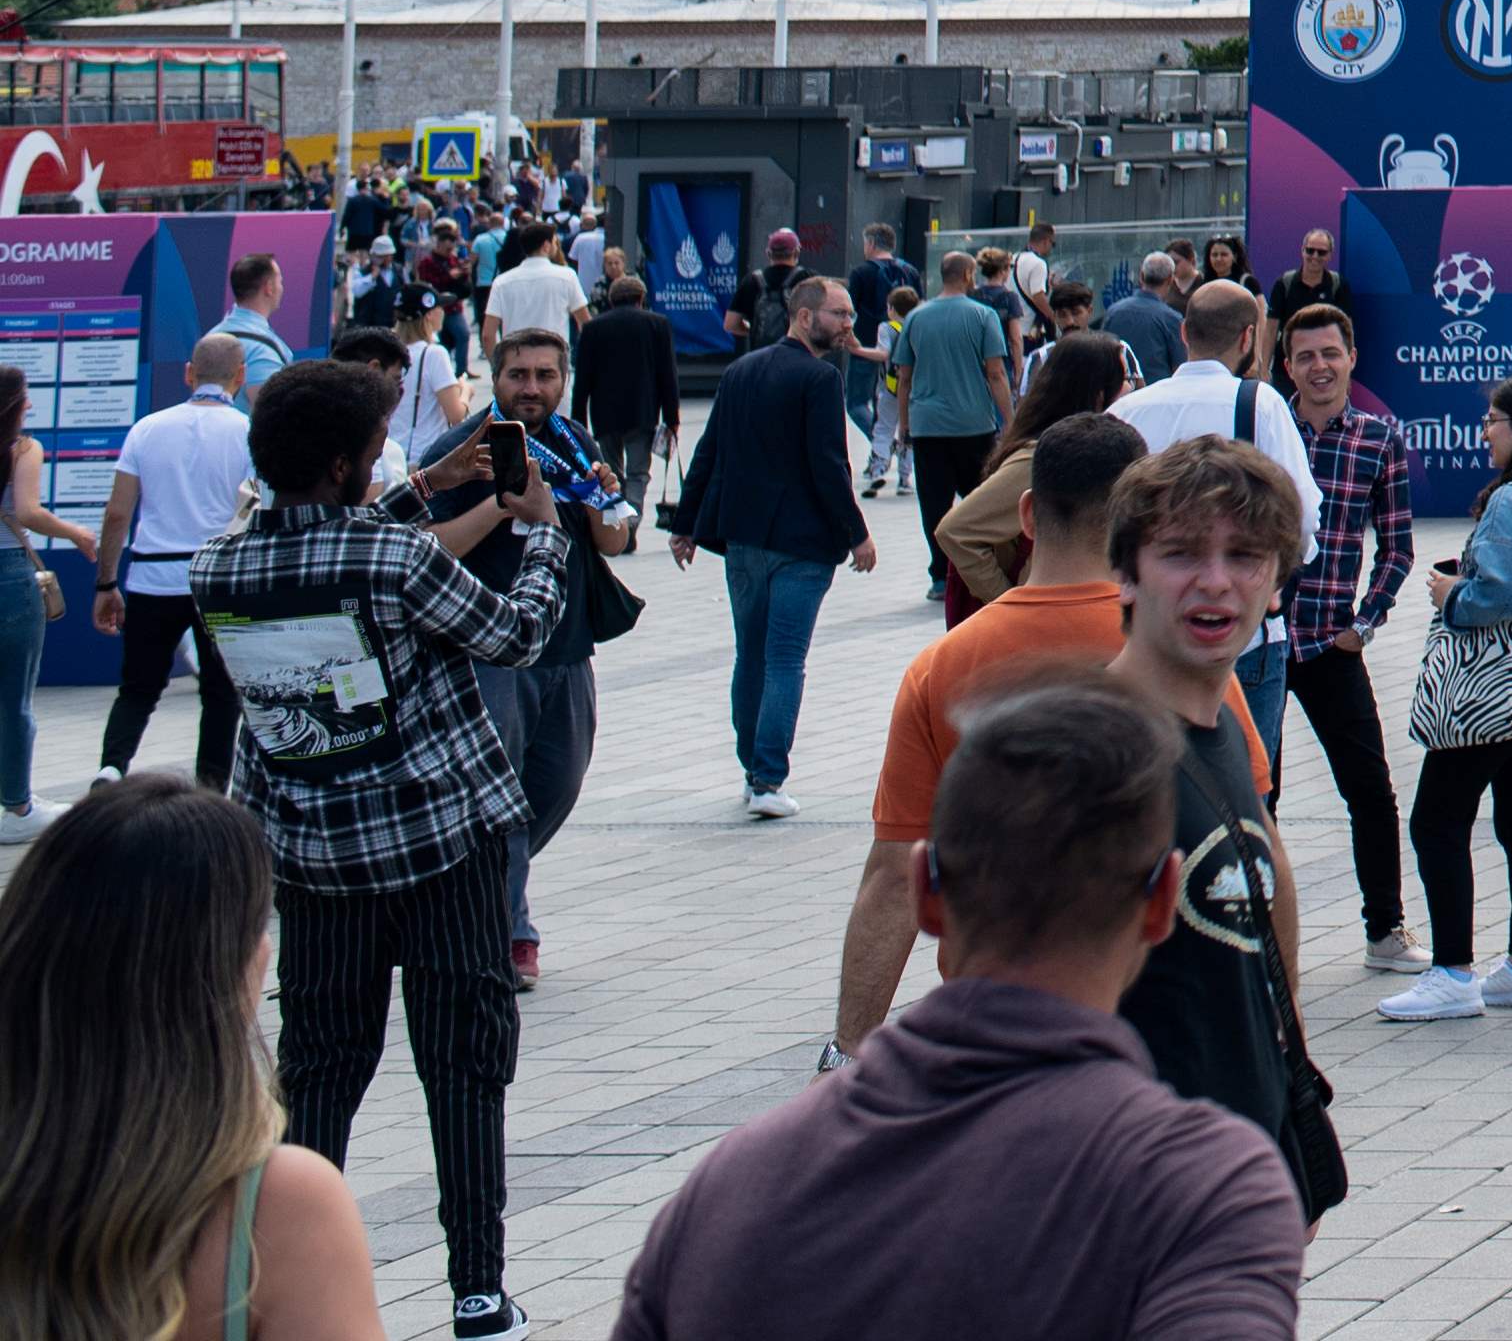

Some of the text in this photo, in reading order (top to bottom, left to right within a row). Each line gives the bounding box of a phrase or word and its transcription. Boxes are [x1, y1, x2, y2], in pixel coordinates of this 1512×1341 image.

[1333, 63, 1366, 75] CITY
[1442, 324, 1483, 341] UEFA
[1420, 365, 1506, 382] LEAGUE
[1424, 455, 1495, 469] FINAL
